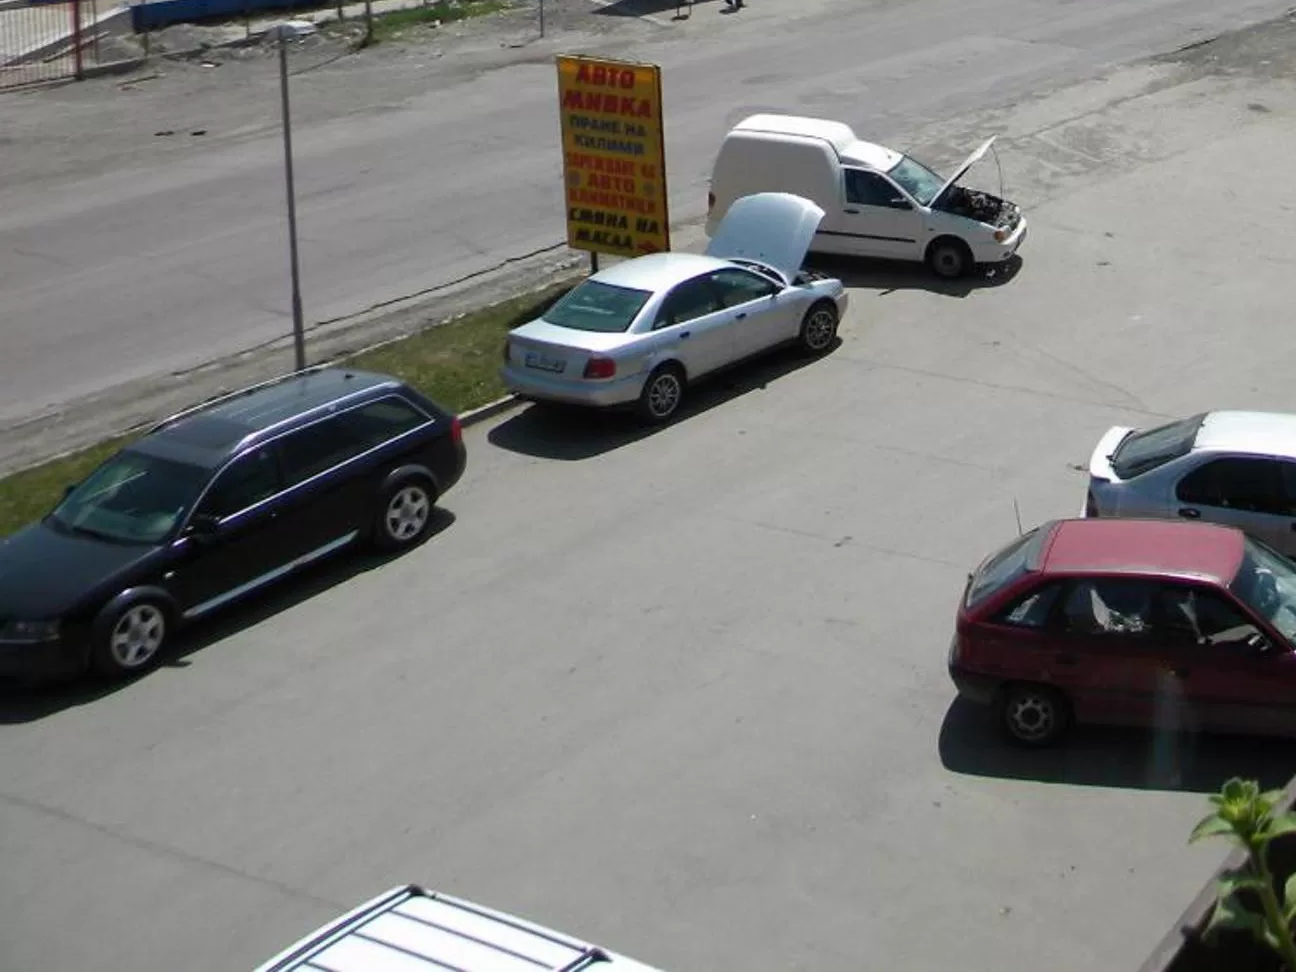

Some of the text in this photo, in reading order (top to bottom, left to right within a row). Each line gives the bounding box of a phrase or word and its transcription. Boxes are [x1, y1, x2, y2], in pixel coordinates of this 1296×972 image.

[575, 63, 635, 89] АВТО
[563, 90, 652, 118] МИВКА
[586, 174, 636, 195] АВТО
[635, 217, 660, 235] НА
